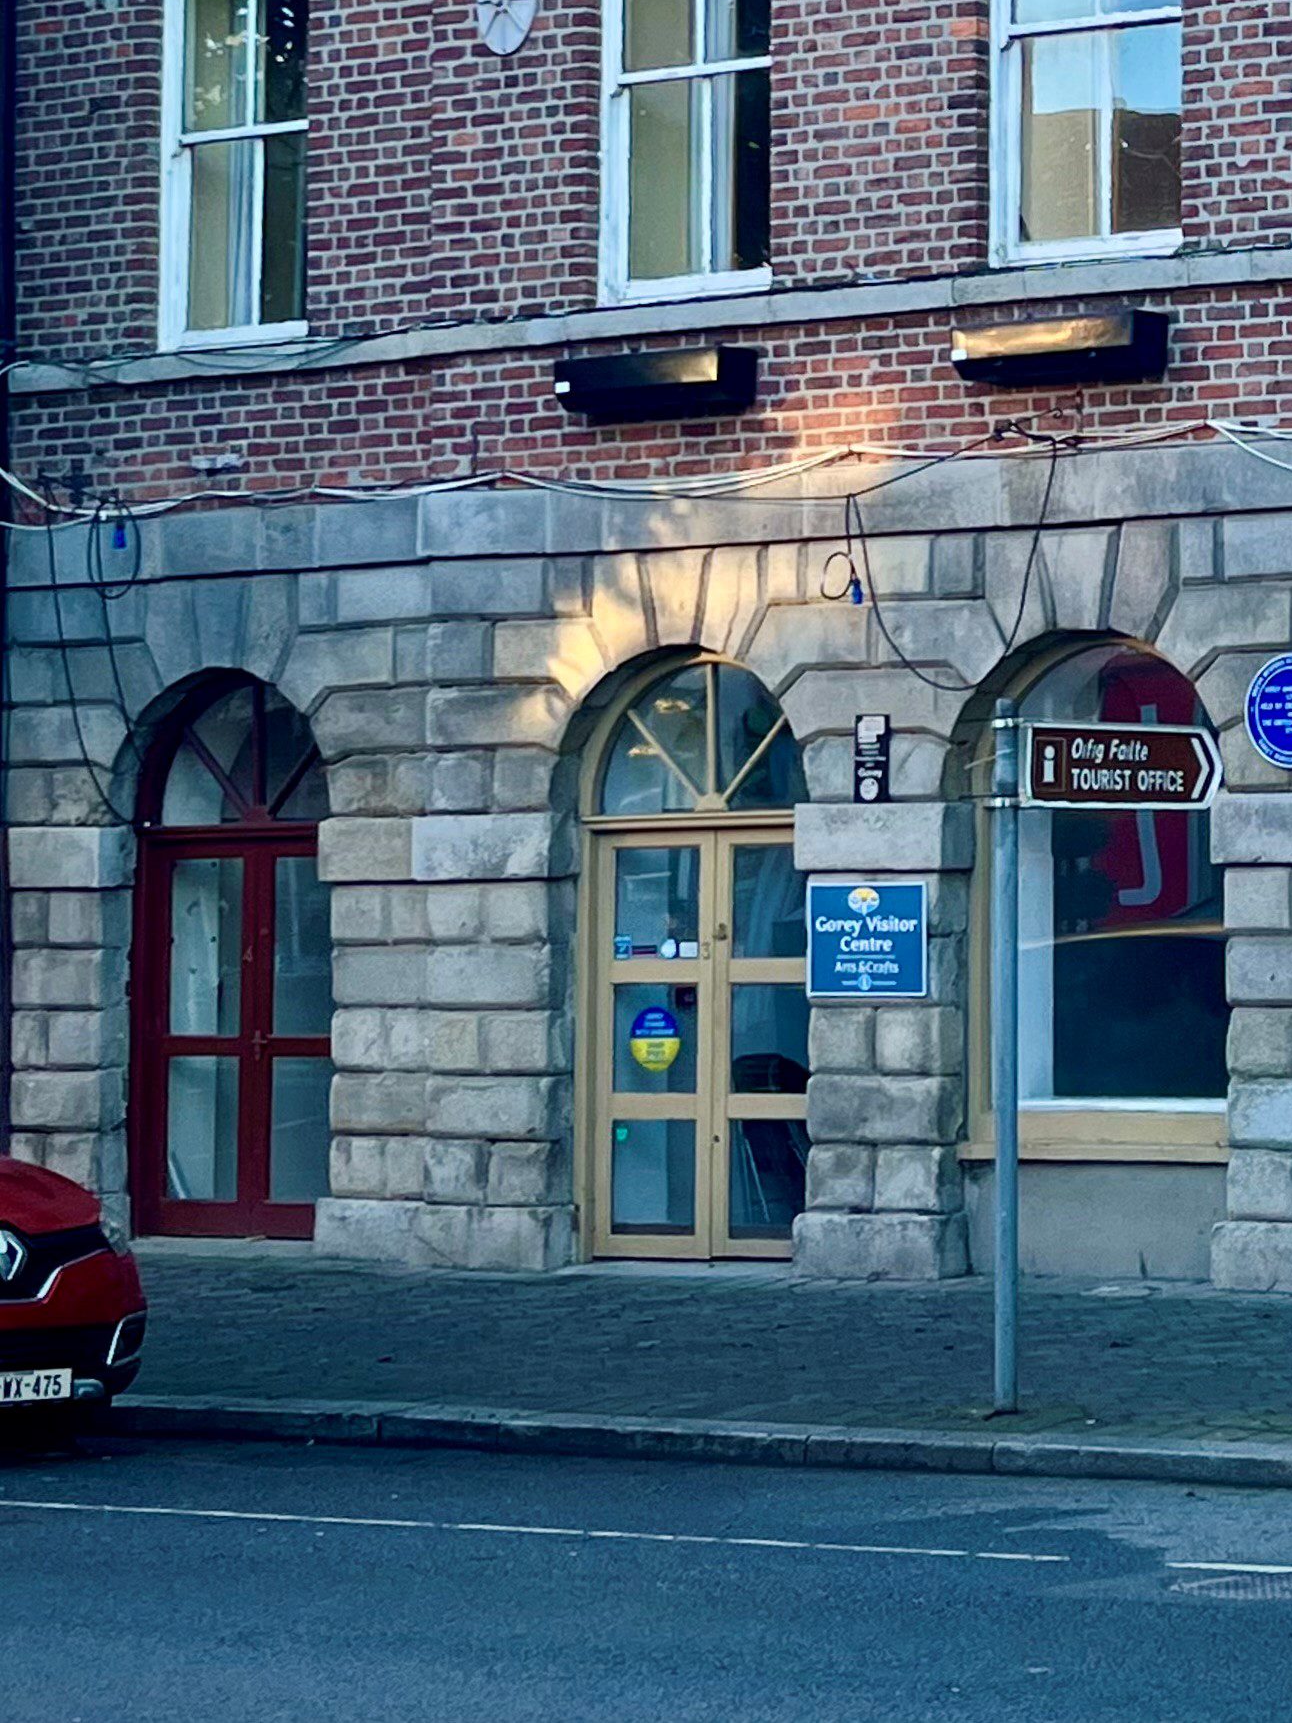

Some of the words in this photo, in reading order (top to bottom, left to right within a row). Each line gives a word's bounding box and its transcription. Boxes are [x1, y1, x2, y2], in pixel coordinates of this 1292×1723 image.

[1071, 768, 1132, 791] TOURIST
[1137, 770, 1185, 792] OFFICE
[815, 916, 863, 938] Gorey
[865, 915, 918, 933] Visitor
[840, 936, 893, 952] Centre
[0, 1374, 62, 1399] WX-475
